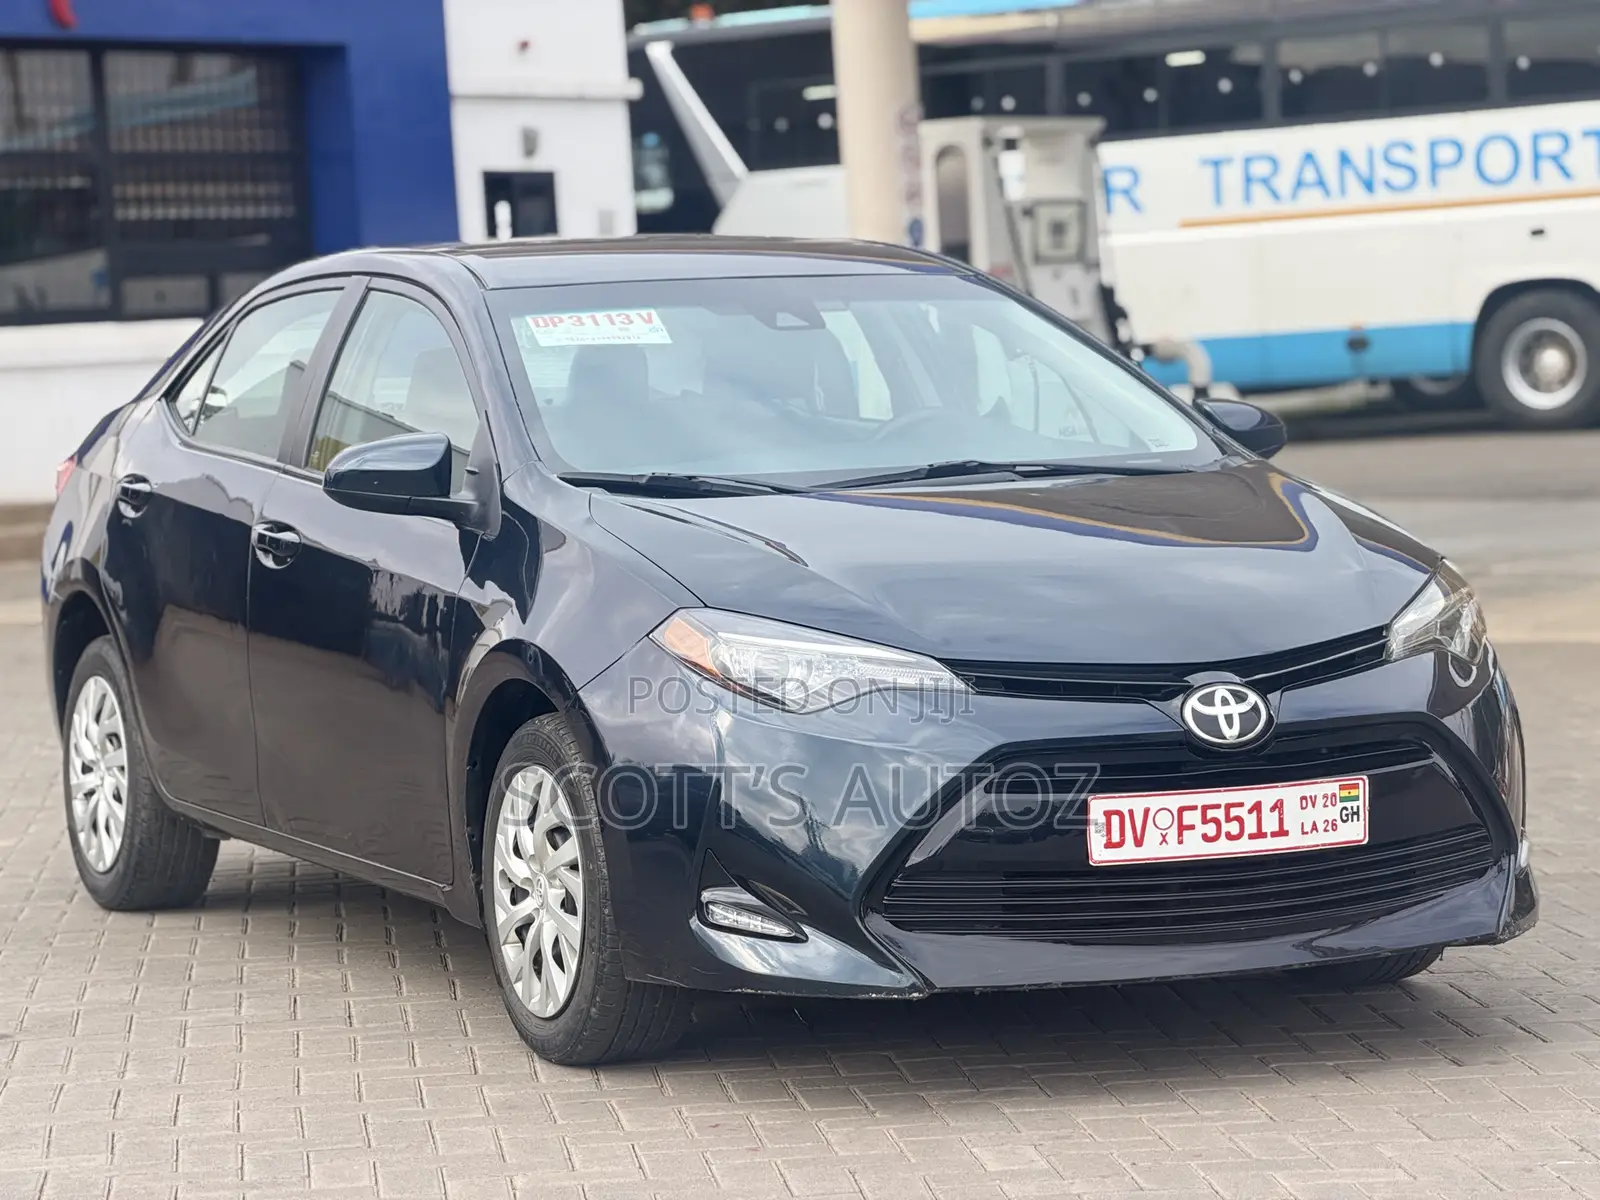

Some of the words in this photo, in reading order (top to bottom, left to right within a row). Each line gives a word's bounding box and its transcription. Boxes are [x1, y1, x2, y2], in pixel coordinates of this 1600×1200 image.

[1300, 794, 1318, 811] DV
[1322, 792, 1338, 808] 20
[1103, 806, 1151, 849] DV
[1177, 798, 1290, 845] F5511
[1340, 805, 1361, 824] GH
[1301, 820, 1320, 836] LA
[1323, 818, 1339, 833] 26
